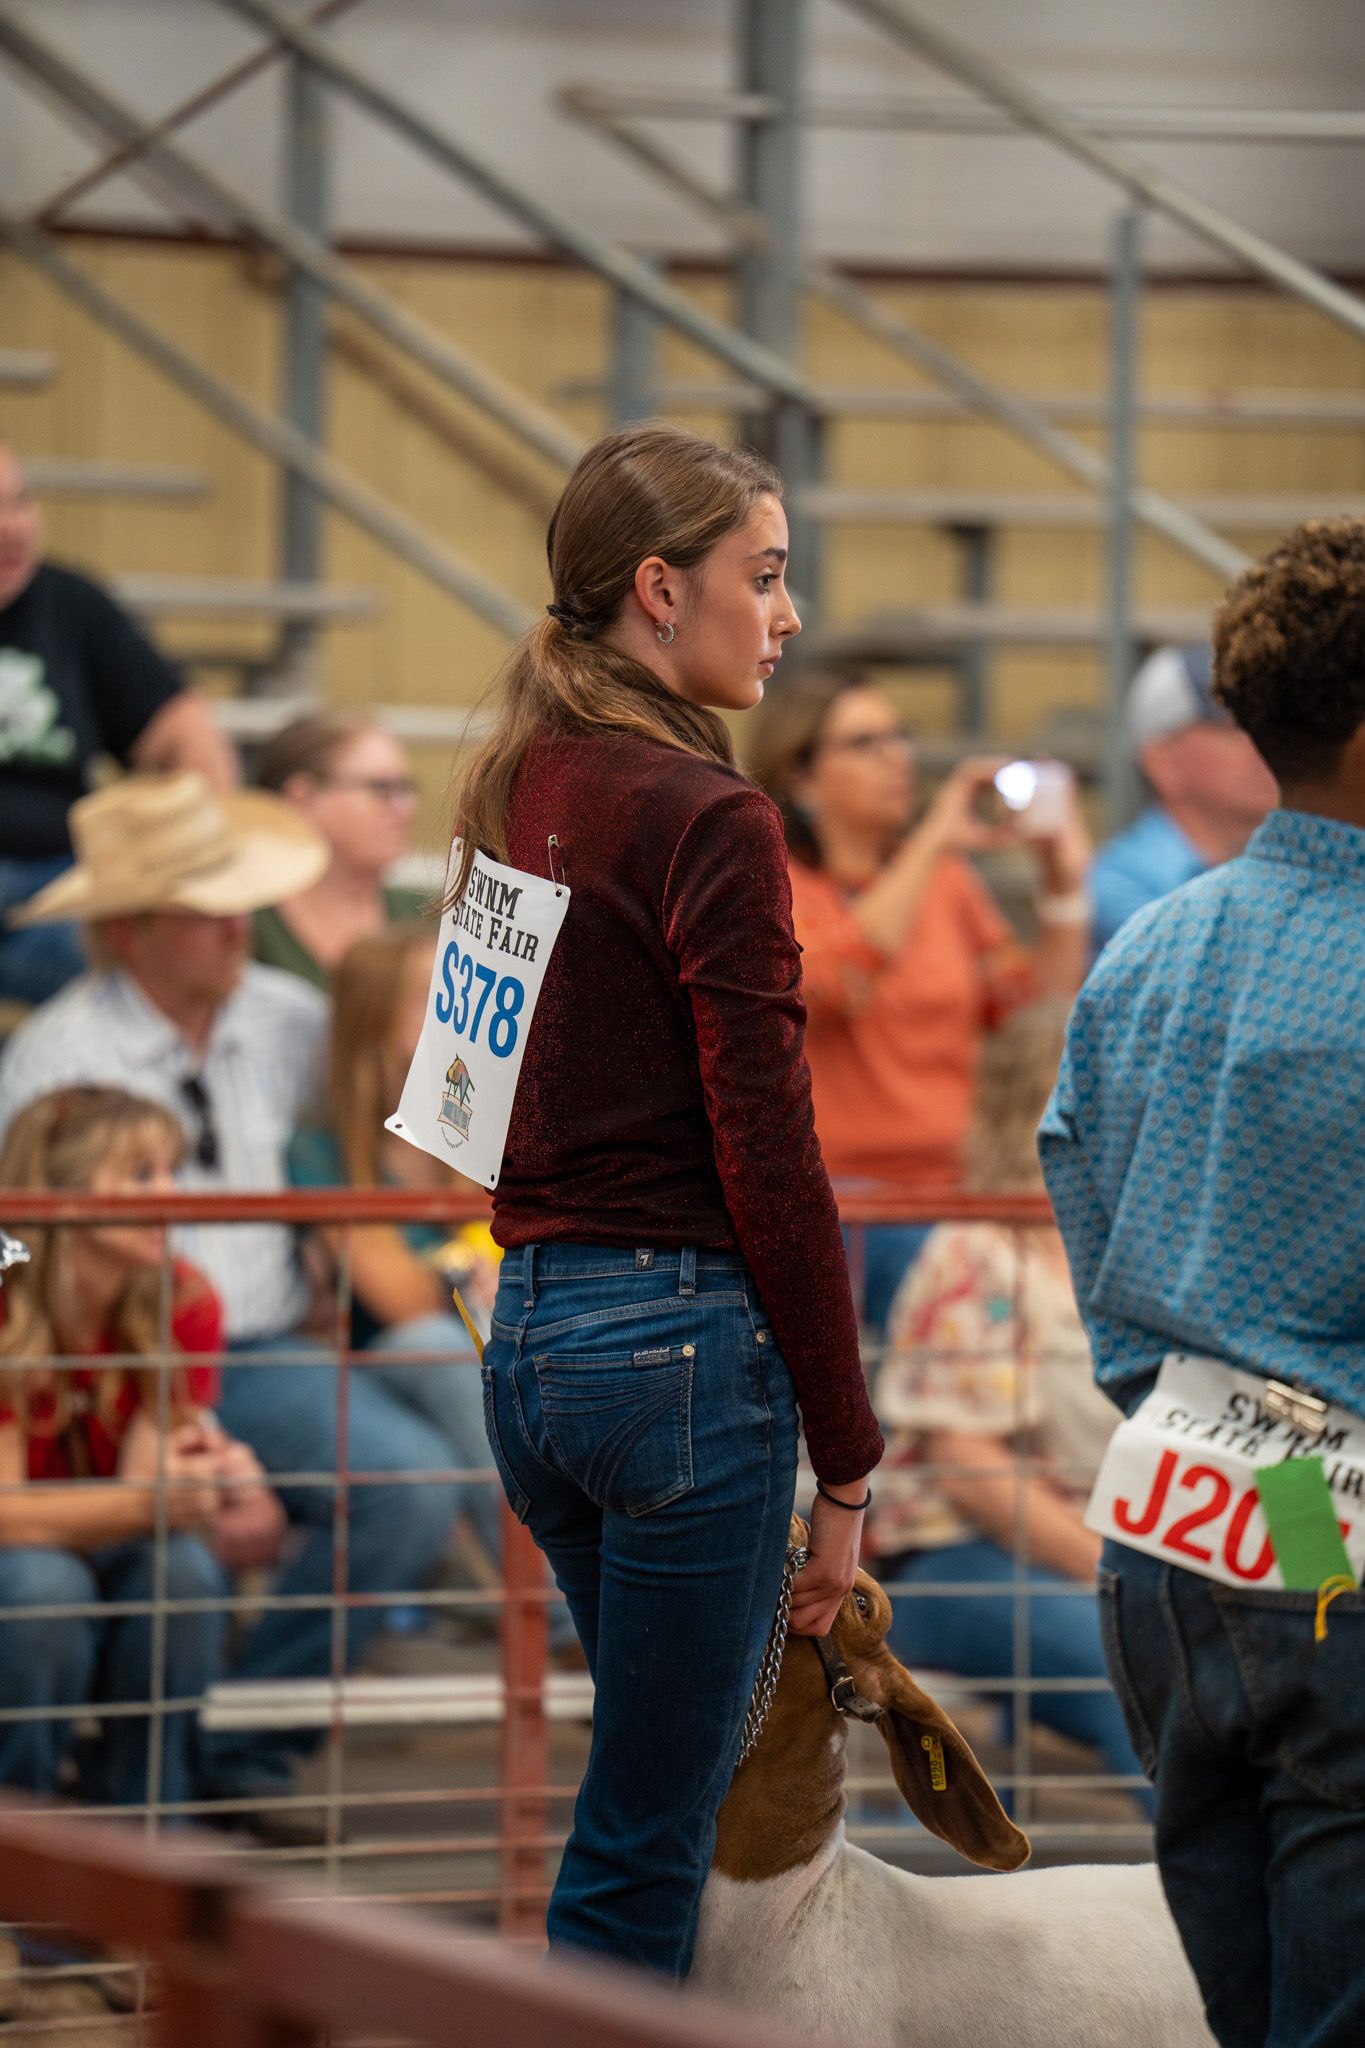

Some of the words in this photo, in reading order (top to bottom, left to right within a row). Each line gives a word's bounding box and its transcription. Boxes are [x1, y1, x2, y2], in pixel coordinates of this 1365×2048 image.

[452, 899, 484, 940] STATE
[487, 916, 539, 962] FAIR
[469, 865, 523, 920] SWNM
[435, 940, 525, 1059] S378
[1112, 1448, 1351, 1581] J20
